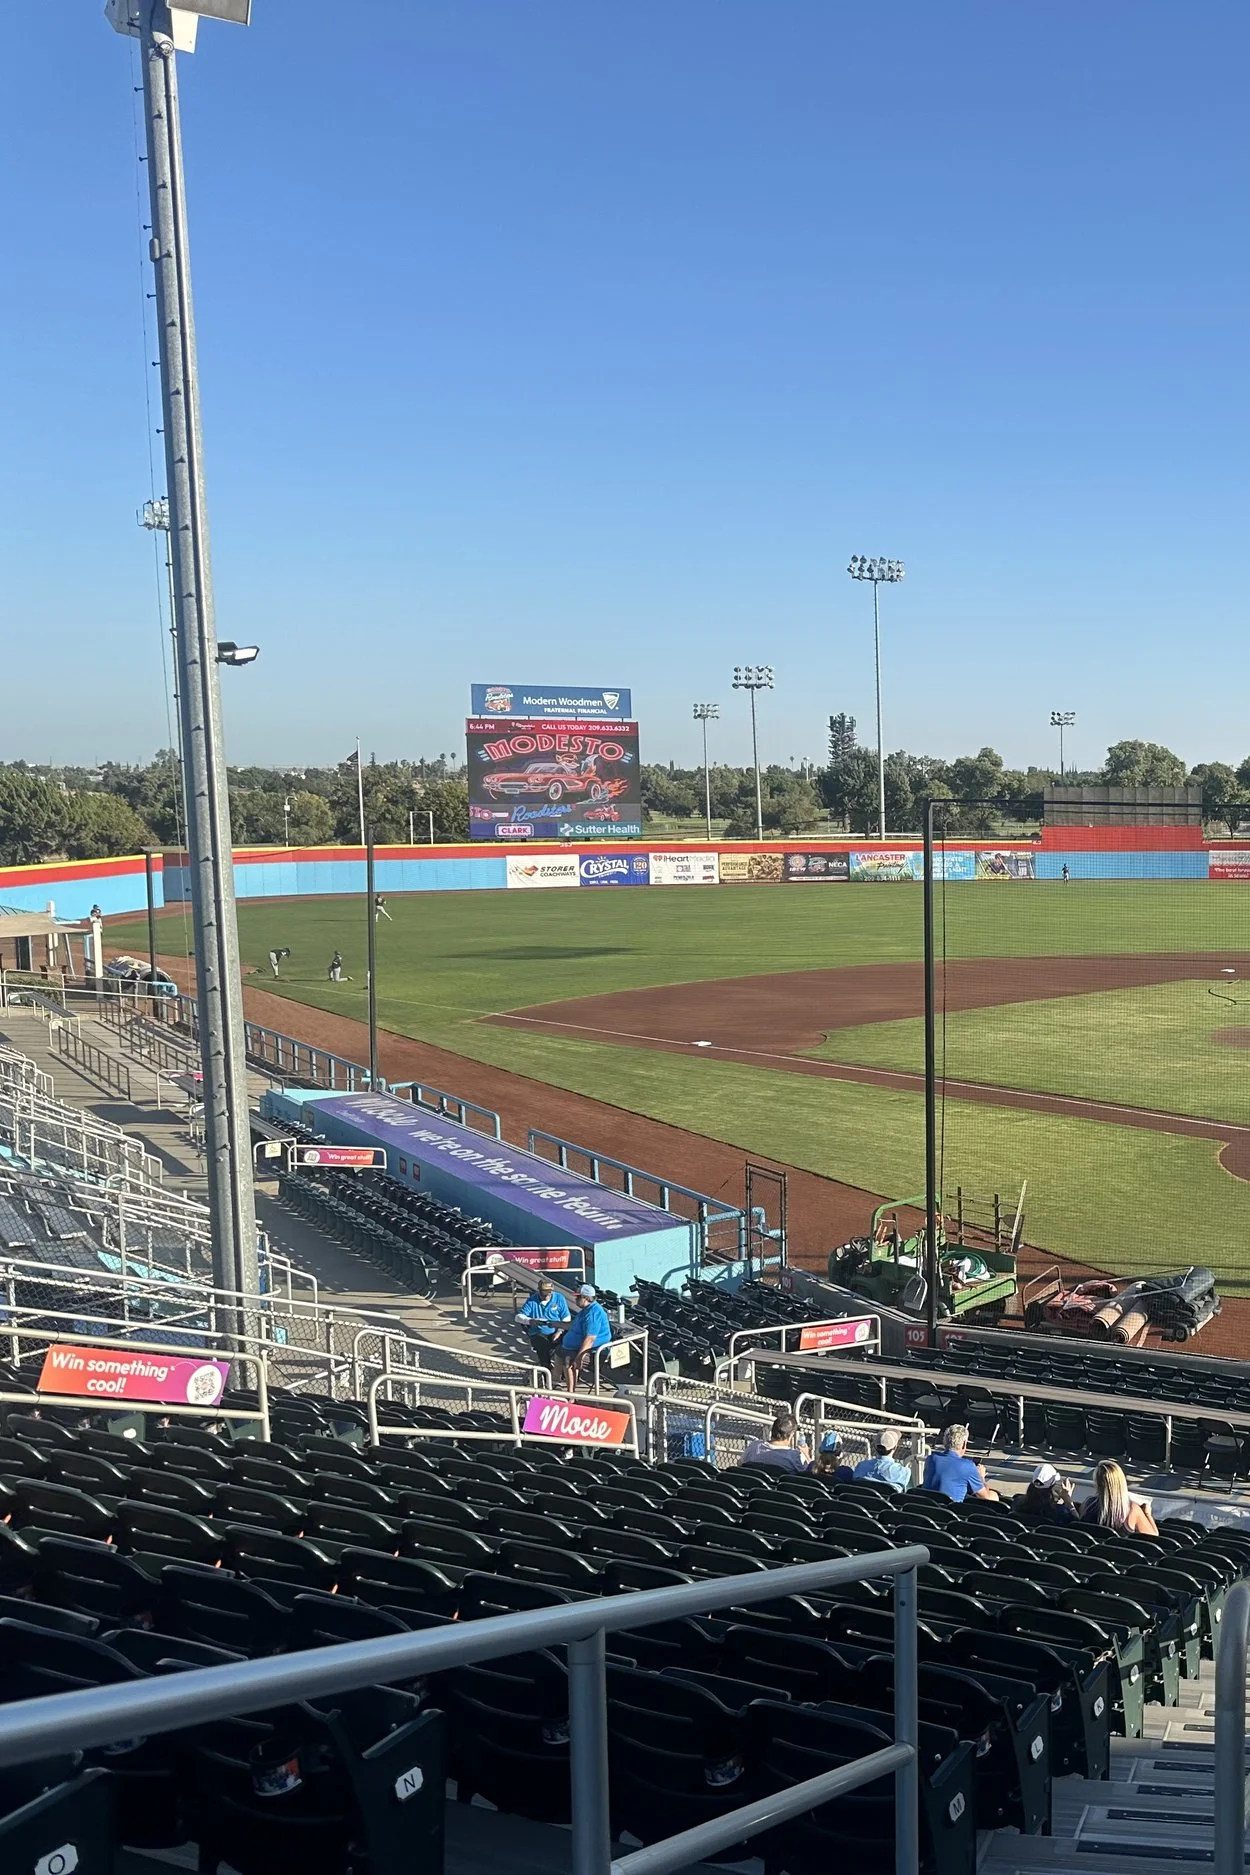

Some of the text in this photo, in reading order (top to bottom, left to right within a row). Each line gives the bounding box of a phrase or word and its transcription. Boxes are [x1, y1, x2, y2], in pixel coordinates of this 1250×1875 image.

[522, 696, 603, 707] Modern Woodmen
[484, 734, 624, 761] MODESTO
[501, 827, 528, 835] CLARK
[575, 824, 640, 835] Sutter Health
[580, 859, 630, 878] CRYSTAL
[633, 861, 647, 869] 120
[408, 1129, 461, 1151] we're
[449, 1149, 484, 1161] on
[471, 1158, 514, 1175] the
[501, 1174, 566, 1198] same
[514, 1256, 528, 1264] Win
[529, 1256, 548, 1265] great
[803, 1327, 847, 1339] Win something
[907, 1329, 925, 1342] 105
[52, 1351, 168, 1382] Win something
[87, 1377, 126, 1393] cool!
[540, 1404, 612, 1440] Mocse
[403, 1773, 416, 1793] N
[48, 1854, 65, 1875] O
